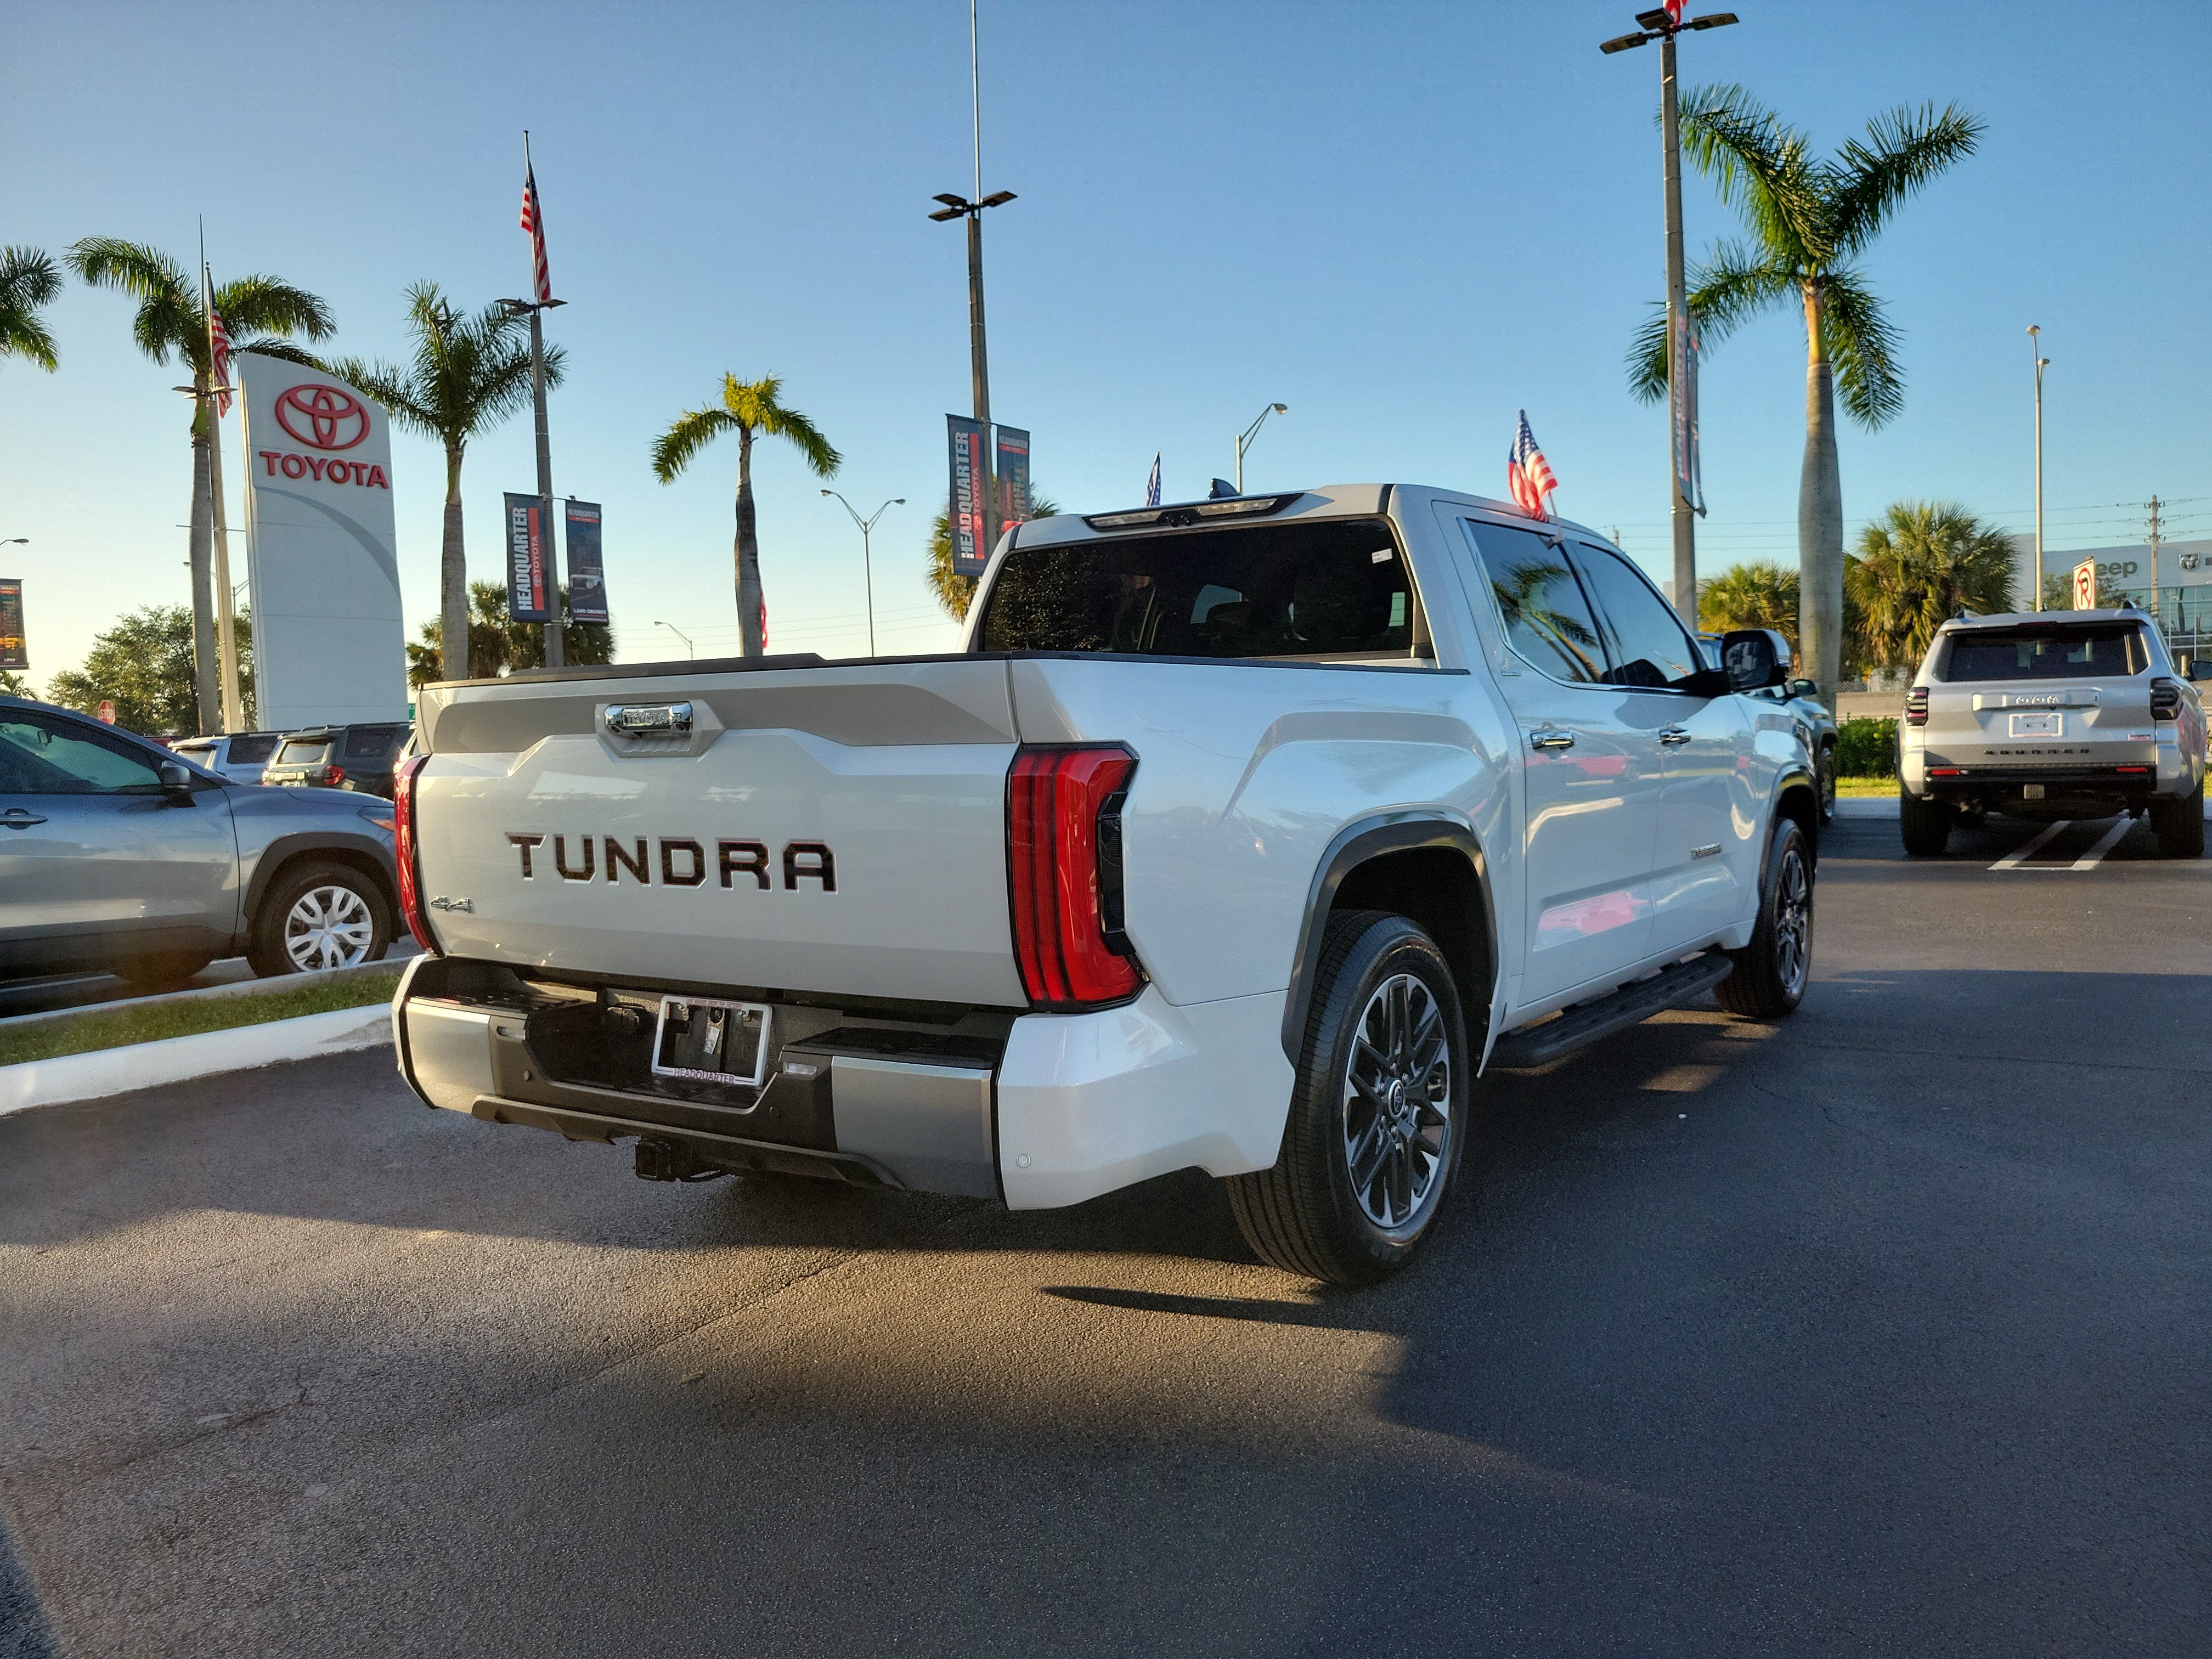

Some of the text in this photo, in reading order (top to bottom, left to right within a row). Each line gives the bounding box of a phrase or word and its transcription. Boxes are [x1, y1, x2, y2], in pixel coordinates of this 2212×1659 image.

[259, 450, 390, 489] TOYOTA
[955, 432, 974, 560] HEADQUARTER
[972, 467, 981, 513] TOYOTA
[512, 507, 534, 611] HEADQUARTER
[532, 535, 543, 574] TOYOTA
[2095, 561, 2138, 578] eep
[100, 708, 114, 719] STOP
[626, 712, 668, 726] TOYOTA
[505, 832, 838, 895] TUNDRA
[674, 1067, 735, 1084] HEADQUARTER
